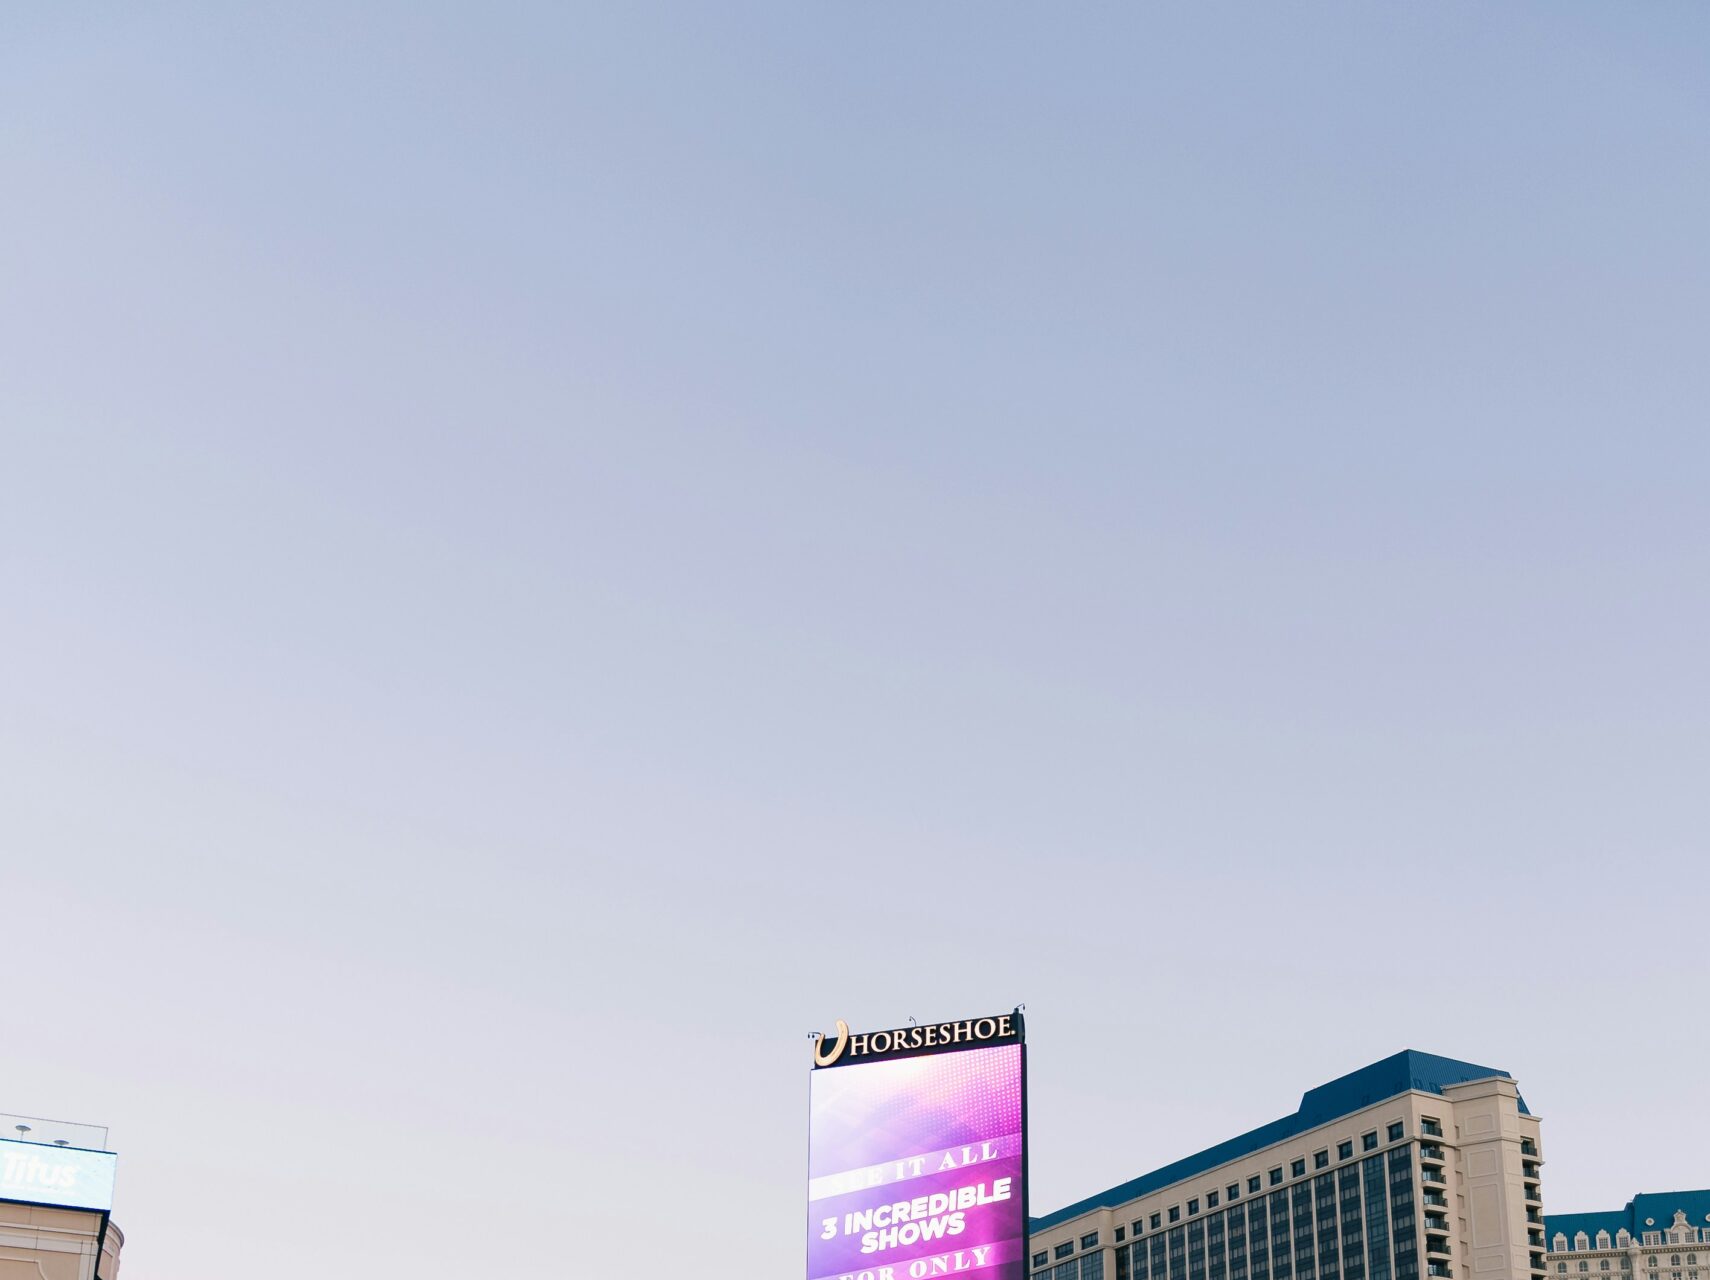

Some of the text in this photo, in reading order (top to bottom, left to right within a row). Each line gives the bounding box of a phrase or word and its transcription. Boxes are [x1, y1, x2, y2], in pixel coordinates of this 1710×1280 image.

[849, 1015, 1012, 1057] HORSESHOE
[895, 1158, 926, 1180] IT
[938, 1142, 998, 1170] ALL
[820, 1177, 1012, 1240] 3 INCREDIBLE
[860, 1212, 966, 1254] SHOWS
[909, 1246, 992, 1279] ONLY
